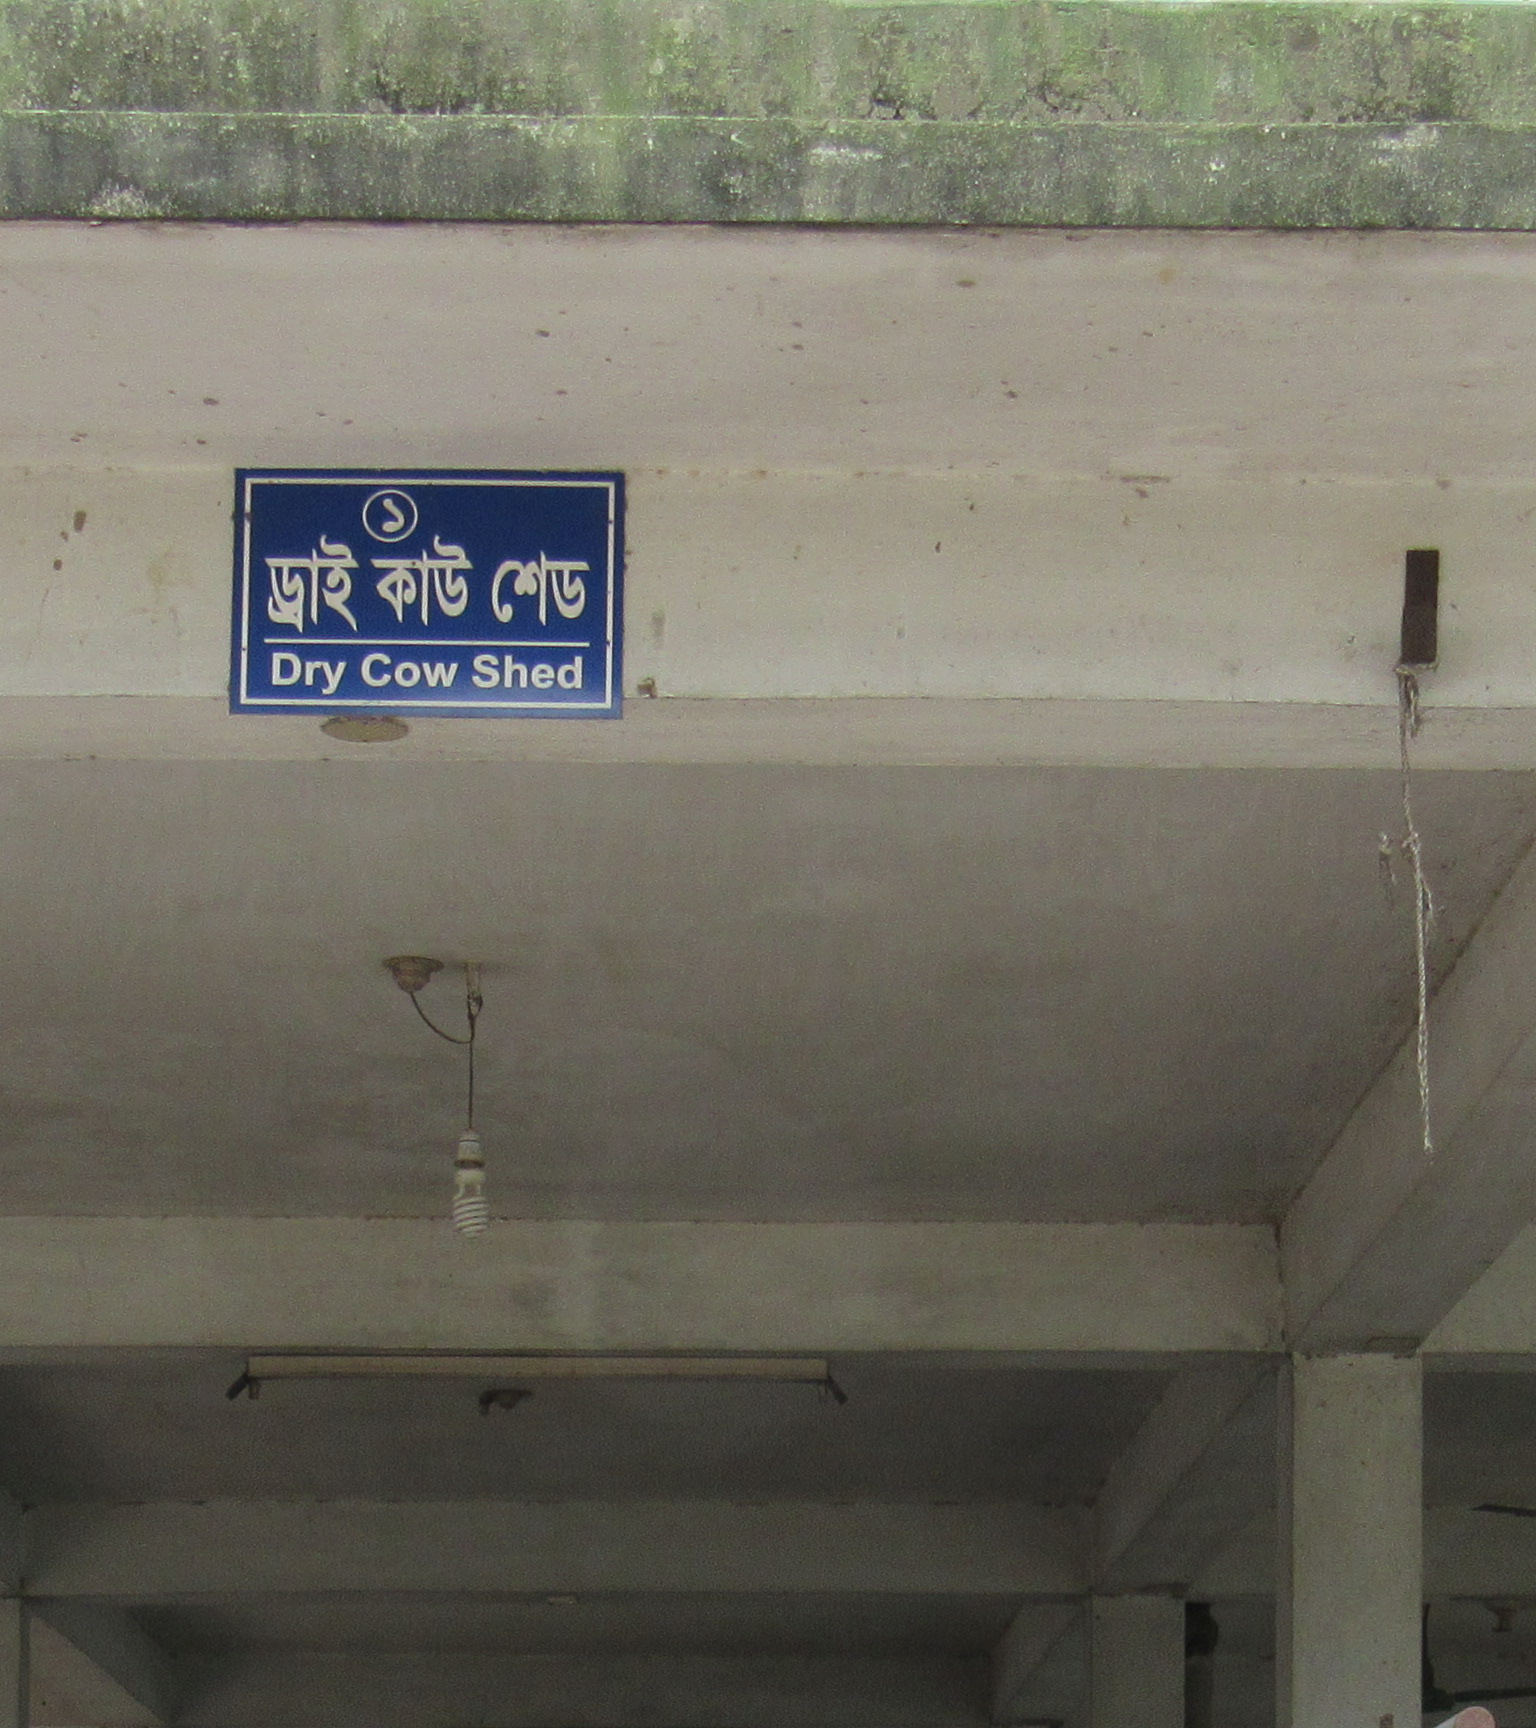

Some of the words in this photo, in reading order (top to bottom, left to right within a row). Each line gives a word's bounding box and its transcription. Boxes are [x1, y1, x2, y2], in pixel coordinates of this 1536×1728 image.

[382, 498, 404, 533] ১
[264, 535, 359, 633] ড্রাই
[370, 535, 473, 626] কাউ
[491, 551, 590, 626] শেড
[271, 652, 347, 694] Dry
[361, 653, 458, 688] Cow
[472, 654, 583, 689] Shed
